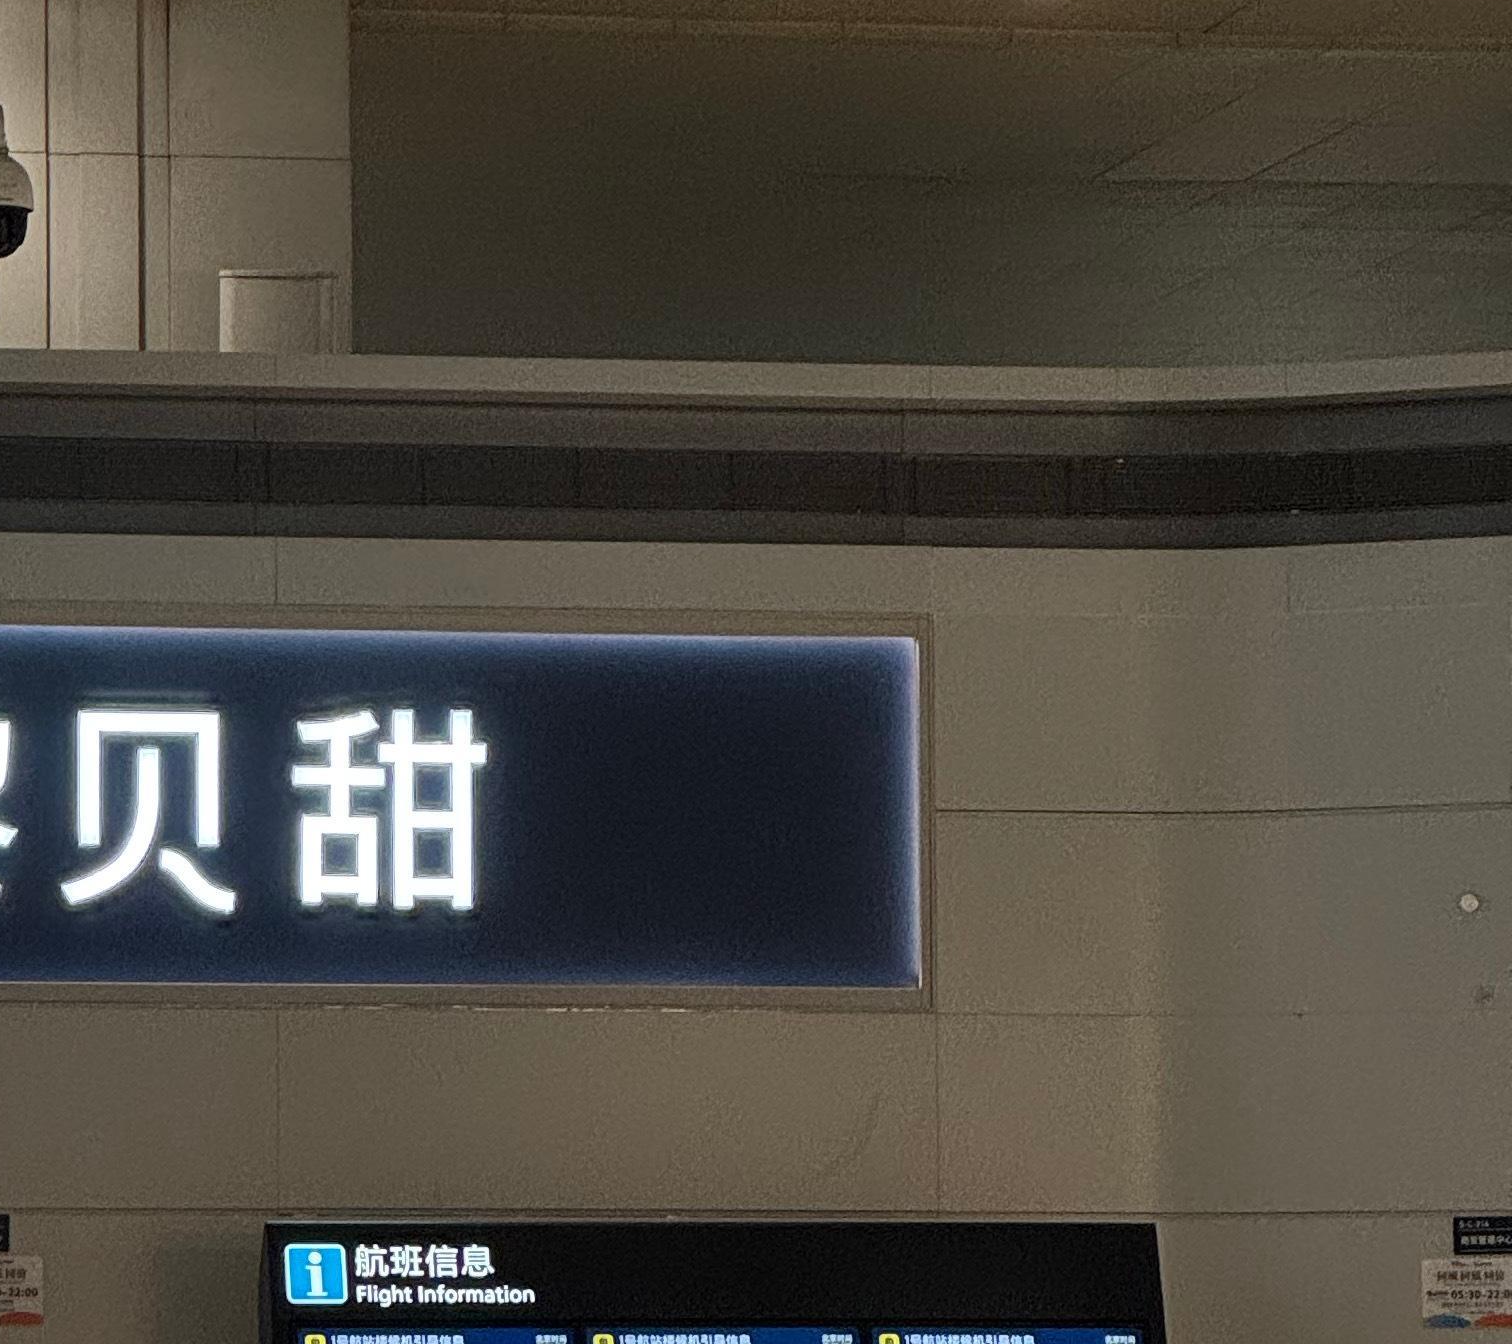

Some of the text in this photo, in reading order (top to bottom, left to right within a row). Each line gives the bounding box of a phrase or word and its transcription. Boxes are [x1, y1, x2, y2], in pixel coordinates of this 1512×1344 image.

[355, 1244, 495, 1278] 航班信息
[356, 1285, 535, 1307] Flight Information
